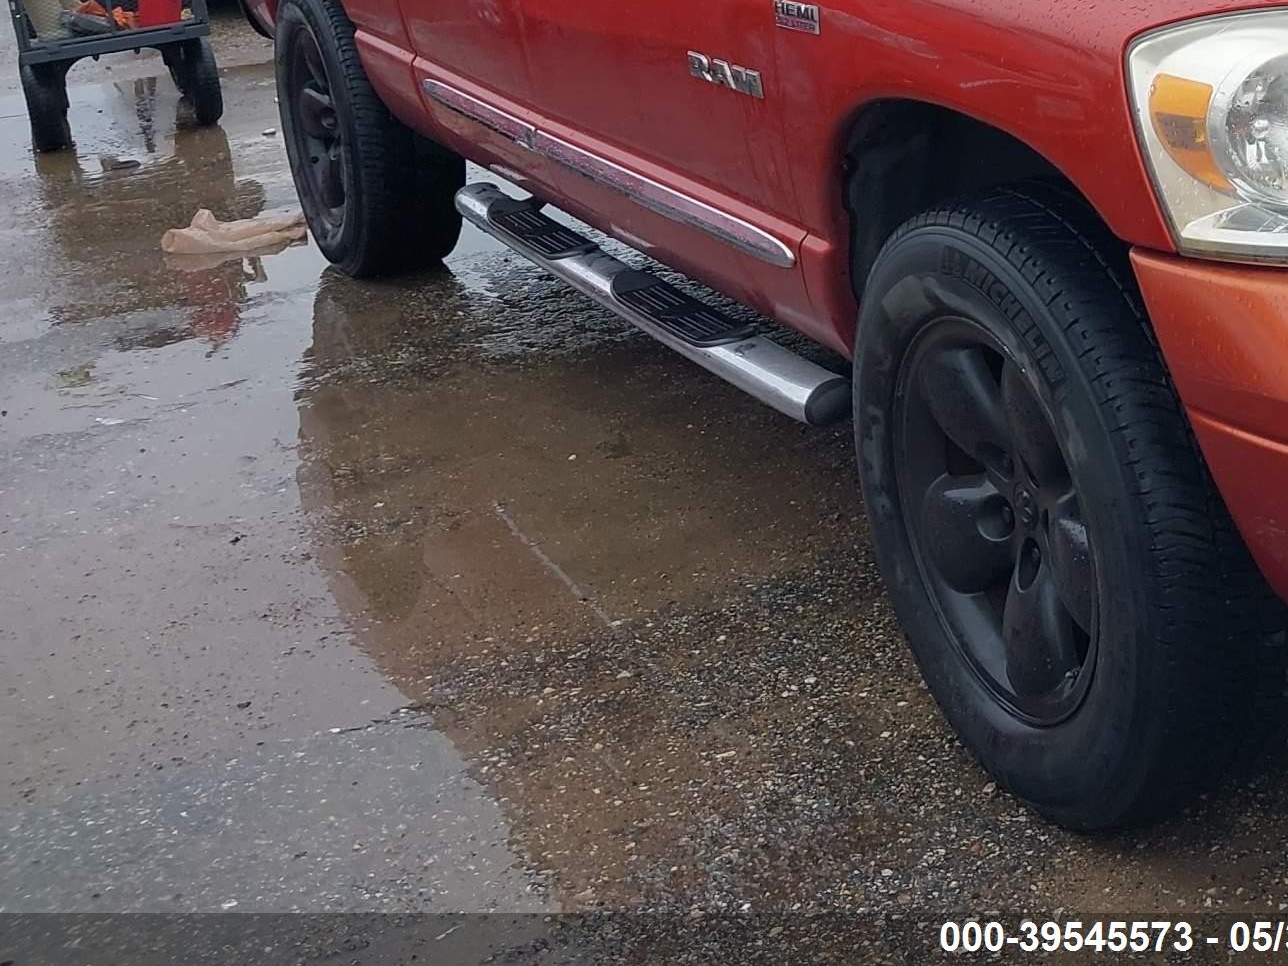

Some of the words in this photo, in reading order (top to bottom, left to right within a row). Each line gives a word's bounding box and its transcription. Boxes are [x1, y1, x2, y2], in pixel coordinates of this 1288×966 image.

[774, 0, 818, 23] HEMI
[687, 50, 764, 99] RAM
[962, 256, 1067, 384] MICHELIN
